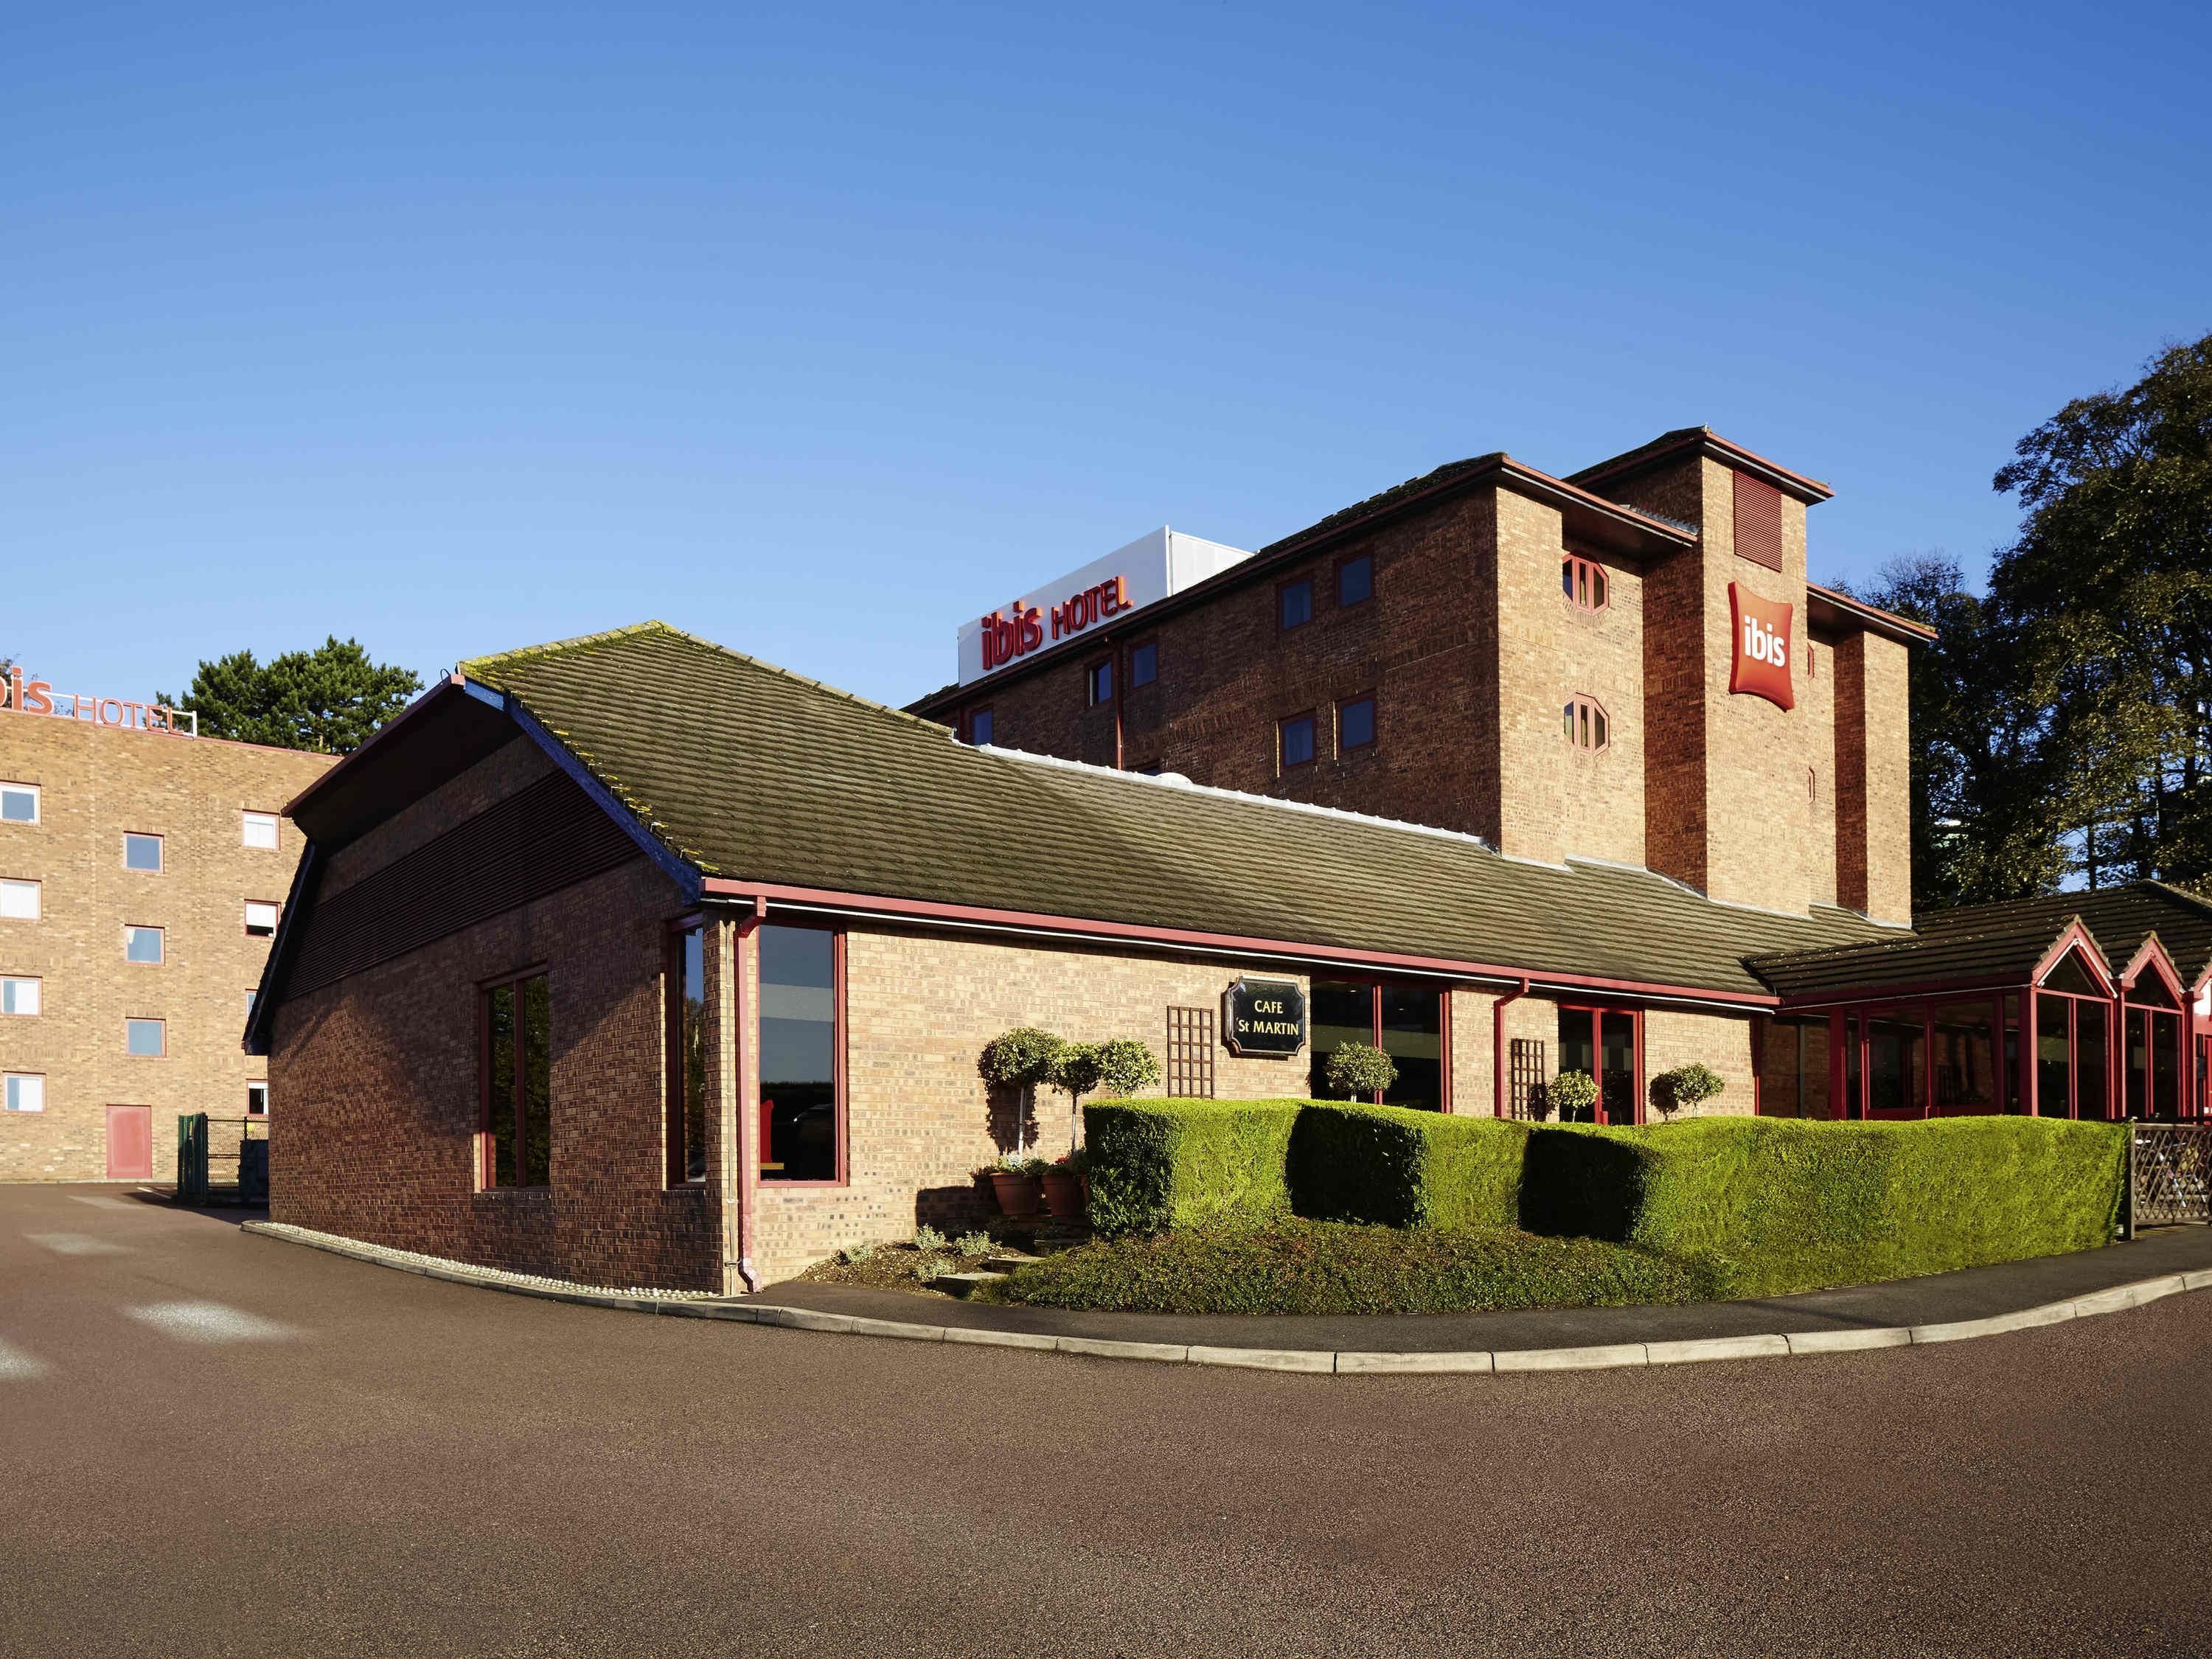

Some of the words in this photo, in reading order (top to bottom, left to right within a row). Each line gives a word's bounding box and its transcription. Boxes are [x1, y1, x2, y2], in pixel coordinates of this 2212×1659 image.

[981, 601, 1043, 670] ibis
[1051, 576, 1133, 640] HOTEL
[1745, 614, 1785, 667] ibis
[74, 694, 184, 735] HOTEL
[1238, 1019, 1250, 1032] St
[1253, 1020, 1298, 1035] MARTIN
[1254, 1000, 1284, 1014] CAFE
